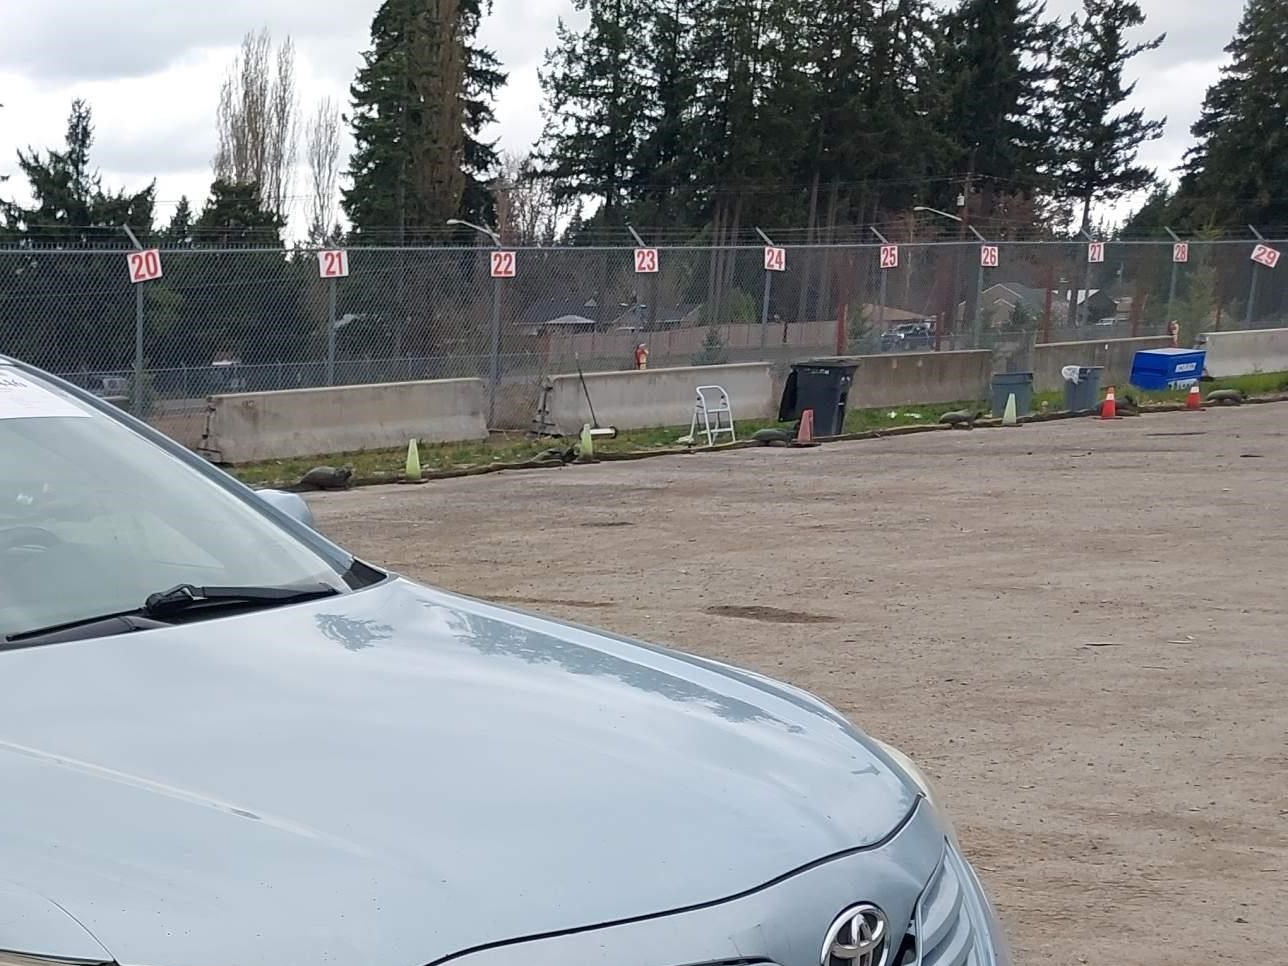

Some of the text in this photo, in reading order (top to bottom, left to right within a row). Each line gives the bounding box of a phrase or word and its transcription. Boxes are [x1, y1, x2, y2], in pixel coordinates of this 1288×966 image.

[636, 249, 656, 272] 23
[765, 248, 784, 270] 24
[881, 247, 897, 267] 25
[982, 247, 997, 265] 26
[1090, 244, 1102, 261] 27
[1175, 244, 1186, 261] 28
[1254, 246, 1277, 266] 29
[132, 251, 159, 280] 20
[324, 251, 344, 276] 21
[493, 252, 513, 276] 22
